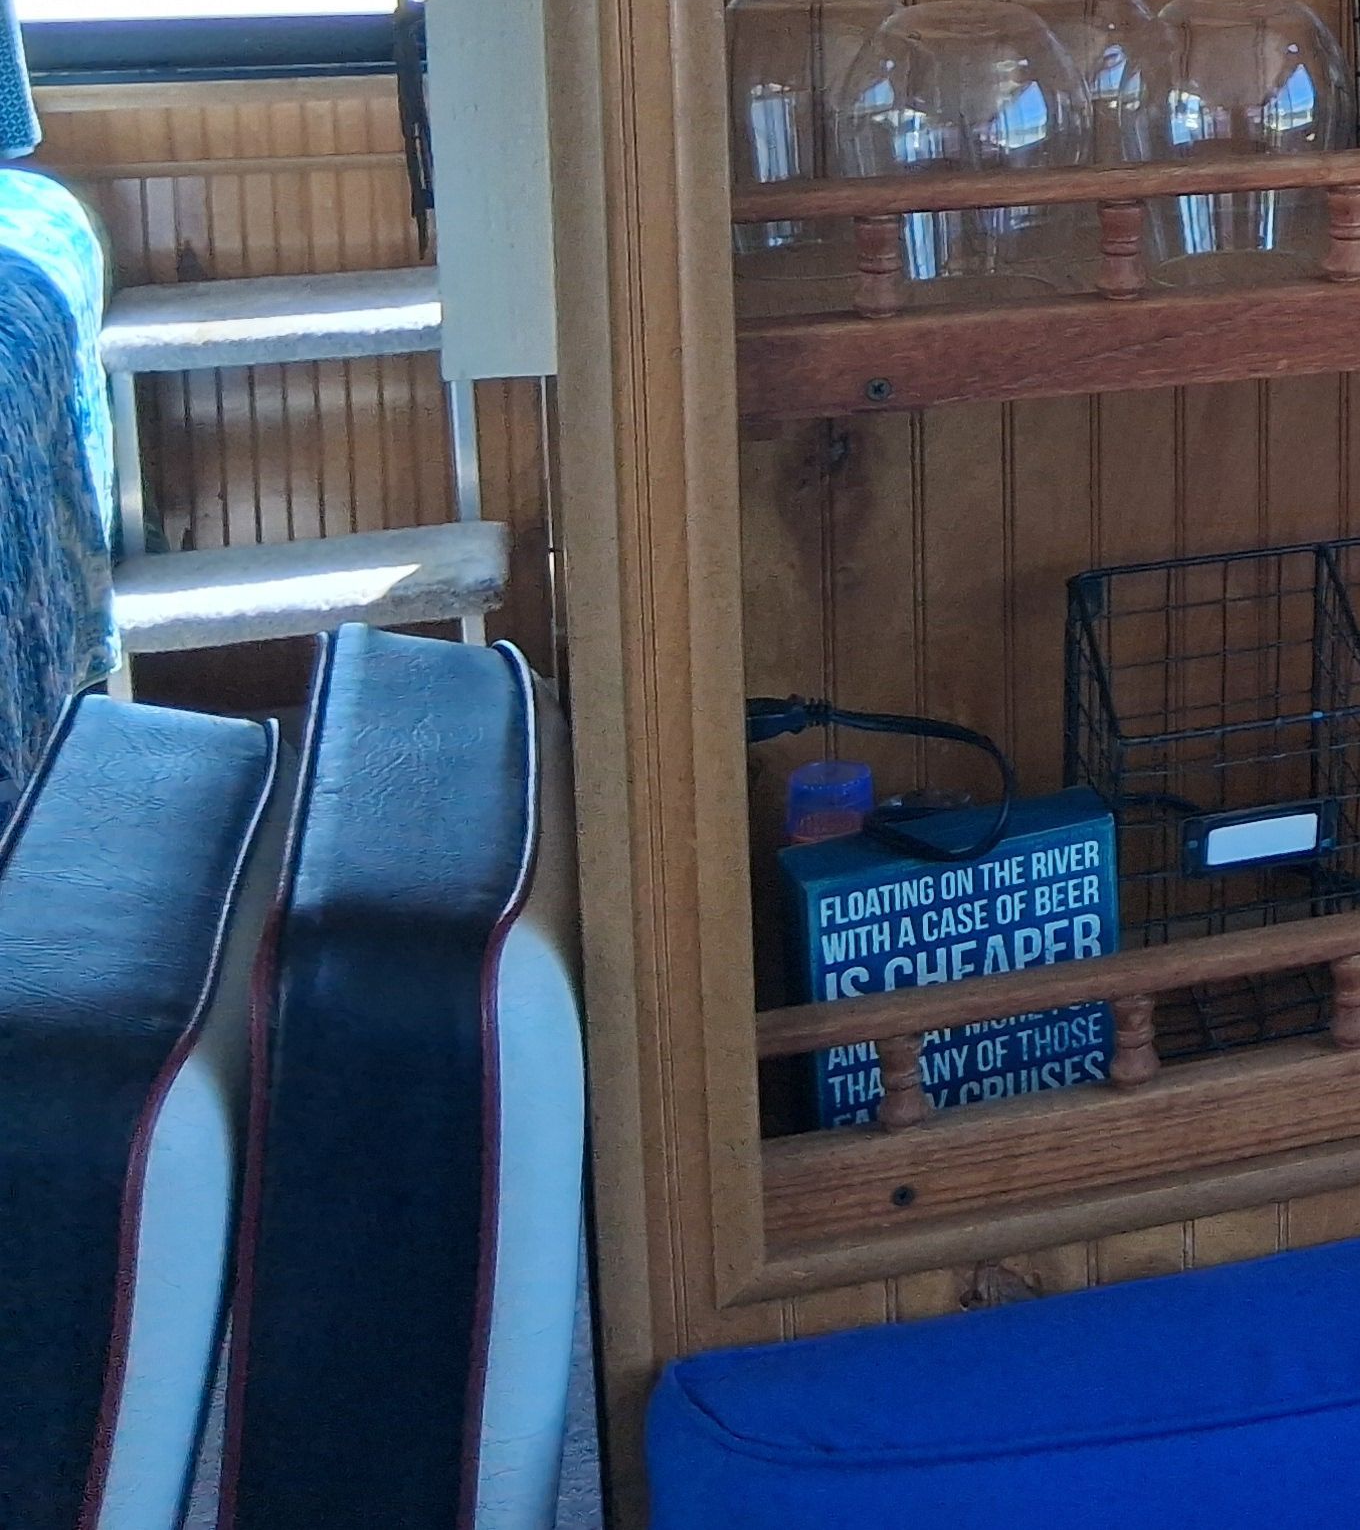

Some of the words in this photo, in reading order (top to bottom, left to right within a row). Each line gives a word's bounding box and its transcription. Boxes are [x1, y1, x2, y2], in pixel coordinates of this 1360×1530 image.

[820, 875, 935, 928] FLOATING
[941, 867, 973, 900] ON
[978, 855, 1025, 891] THE
[1032, 840, 1100, 881] RIVER
[821, 920, 890, 965] WITH
[898, 916, 917, 948] A
[922, 899, 988, 942] CASE
[996, 890, 1028, 925] OF
[1035, 875, 1100, 917] BEER
[825, 966, 870, 1001] IS
[884, 913, 1101, 992] CHEAPER
[828, 1067, 887, 1109] THA
[976, 1030, 1011, 1072] OF
[1017, 1012, 1103, 1061] THOSE
